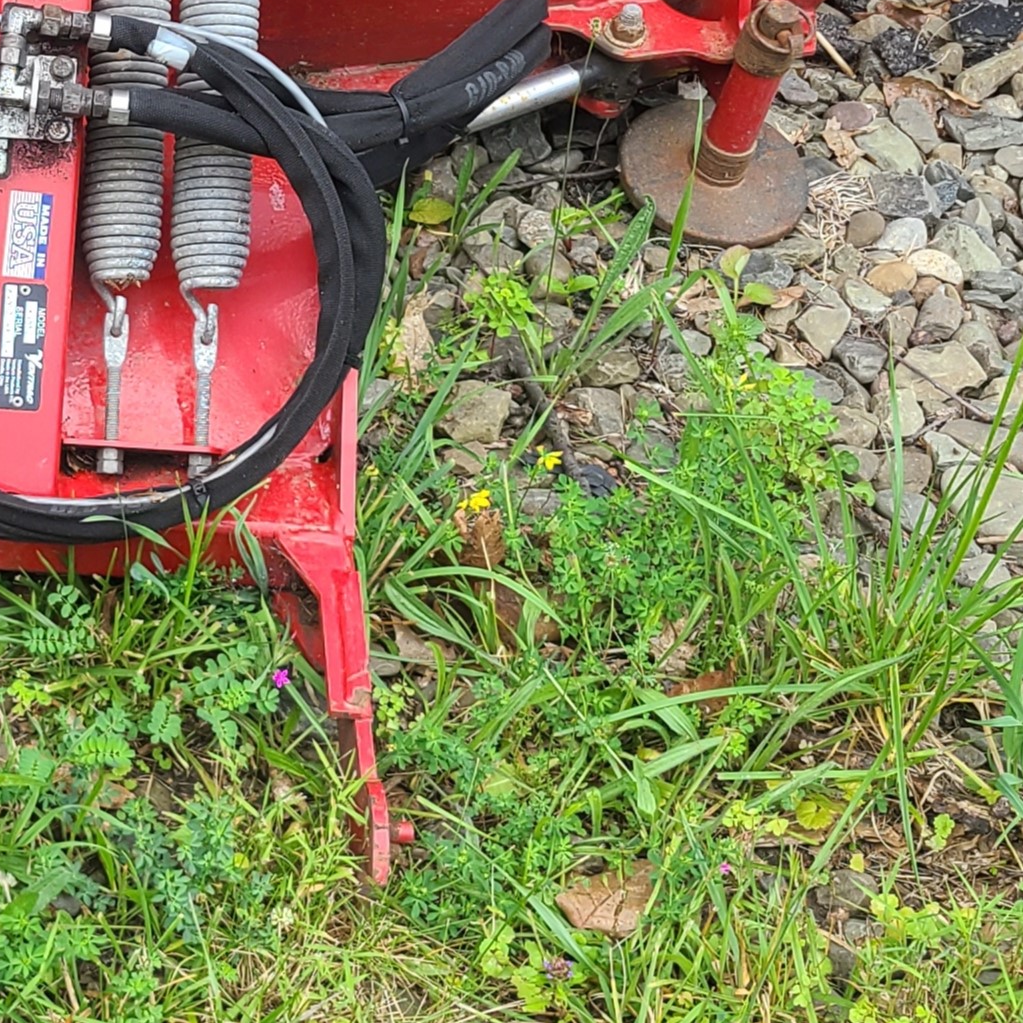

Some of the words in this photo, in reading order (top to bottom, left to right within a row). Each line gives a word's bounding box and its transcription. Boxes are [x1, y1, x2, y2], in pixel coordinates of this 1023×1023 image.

[9, 201, 39, 270] USA
[39, 204, 51, 245] MADE
[36, 253, 46, 267] IN
[14, 306, 24, 336] SERIAL
[36, 307, 46, 339] MODEL
